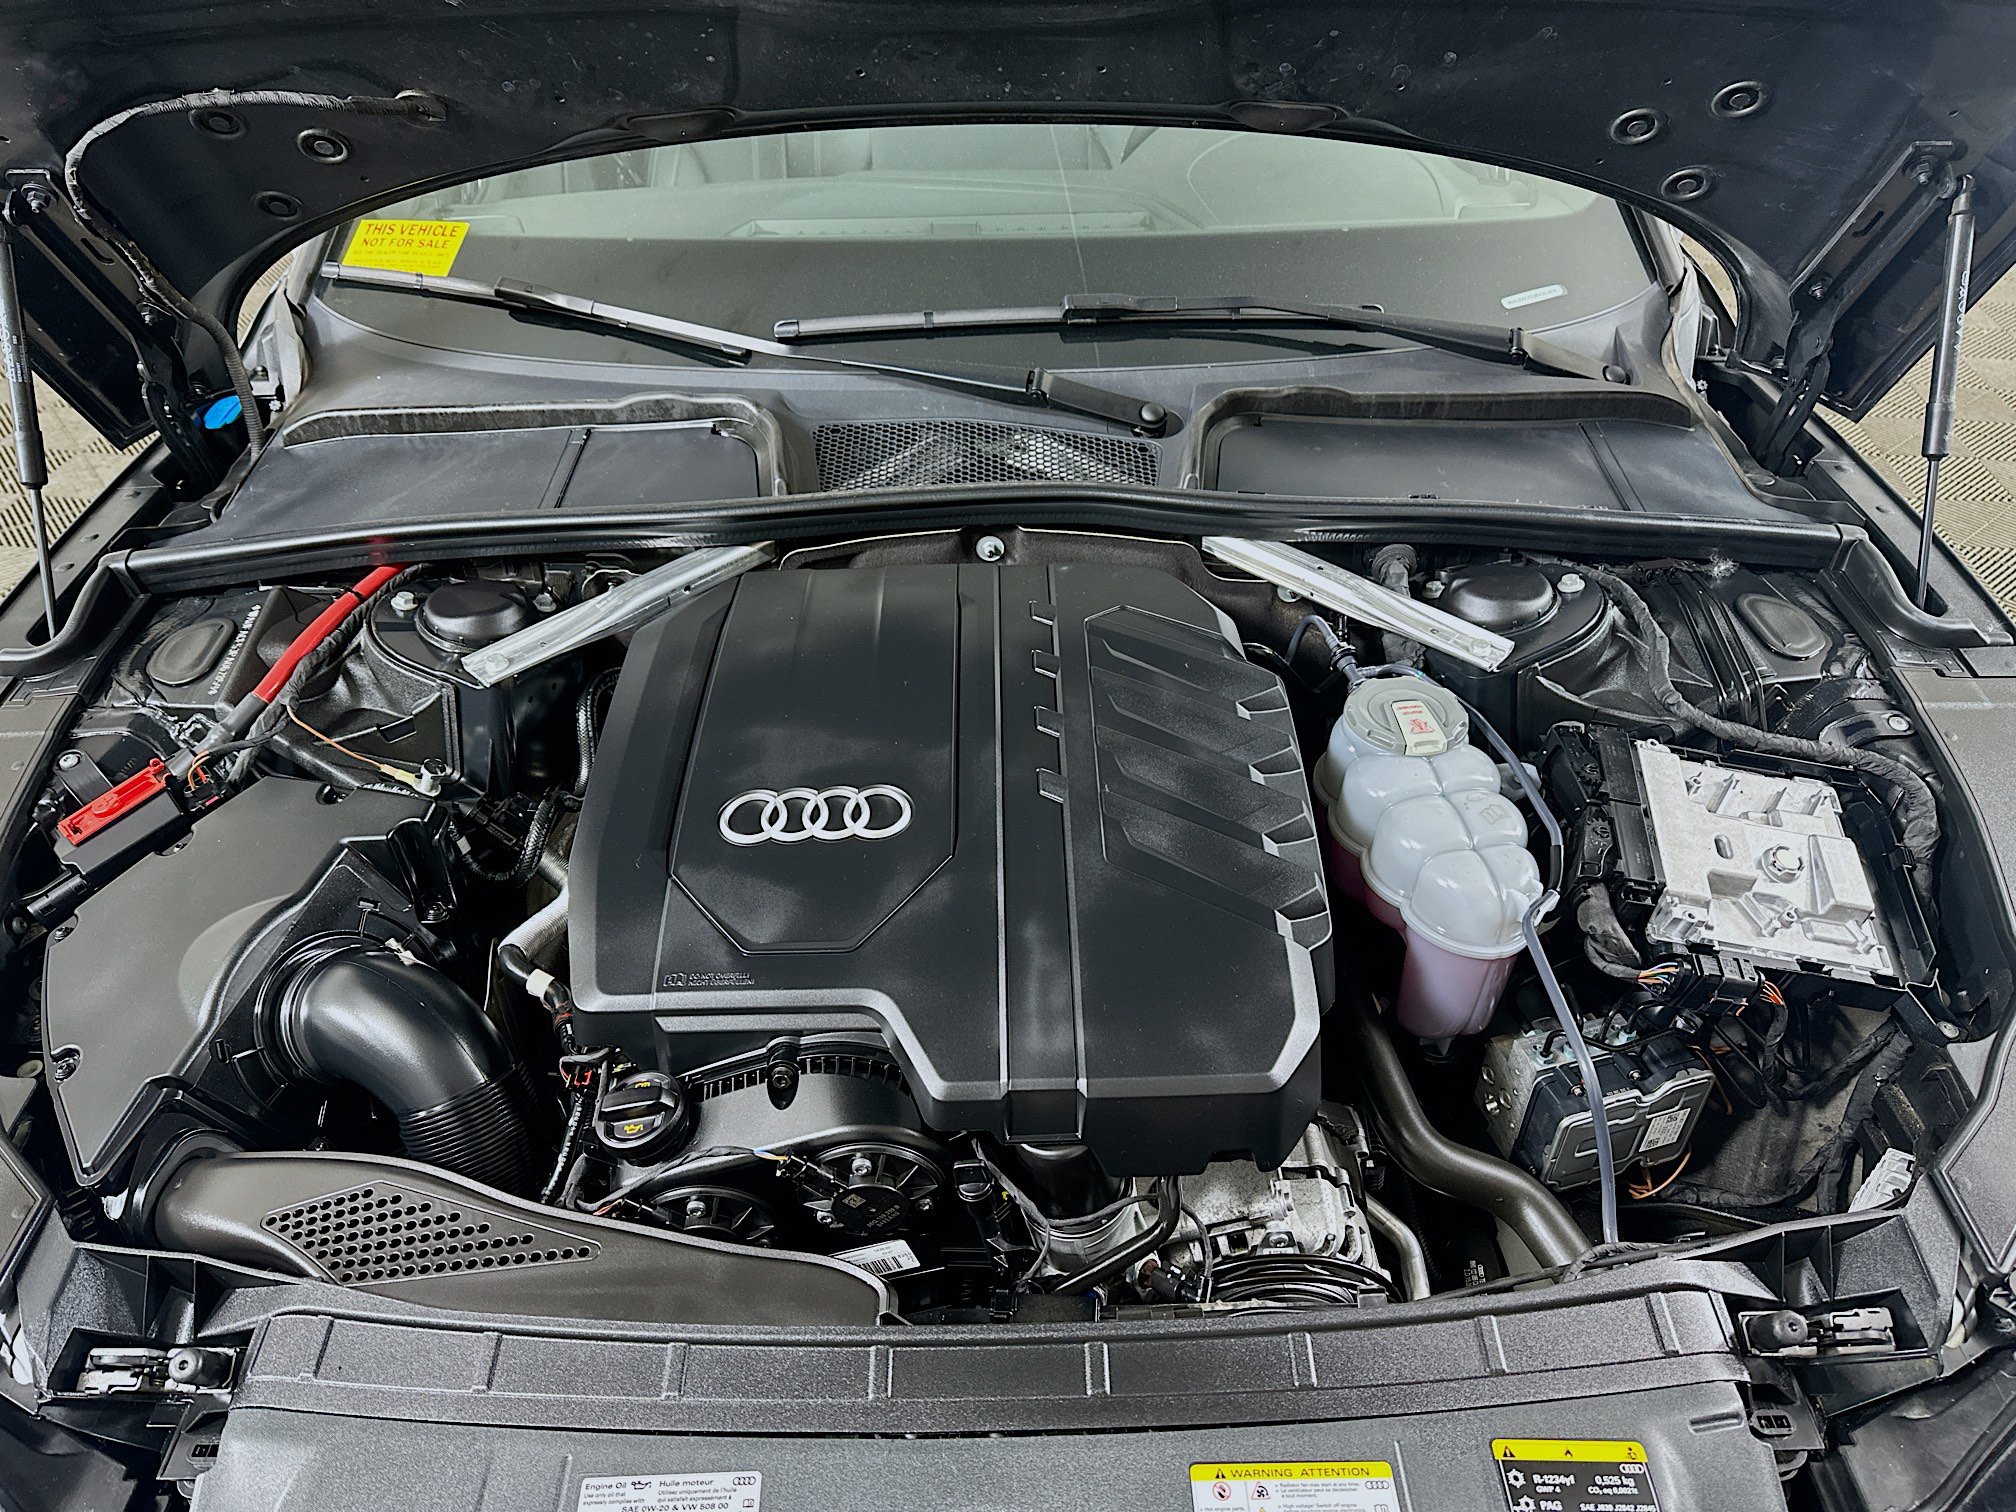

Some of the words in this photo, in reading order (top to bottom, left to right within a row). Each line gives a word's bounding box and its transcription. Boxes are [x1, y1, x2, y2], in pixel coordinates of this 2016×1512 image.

[365, 223, 395, 236] THIS
[400, 224, 460, 237] VEHICLE
[361, 238, 386, 248] NOT
[389, 238, 413, 248] FOR
[418, 239, 450, 249] SALE
[1230, 1468, 1293, 1478] WARNING
[1300, 1467, 1370, 1477] ATTENTION
[585, 1483, 613, 1491] Engine
[1621, 1476, 1636, 1487] kg
[1536, 1485, 1554, 1493] GWP
[1539, 1500, 1563, 1511] PAG
[1579, 1503, 1596, 1512] SAE
